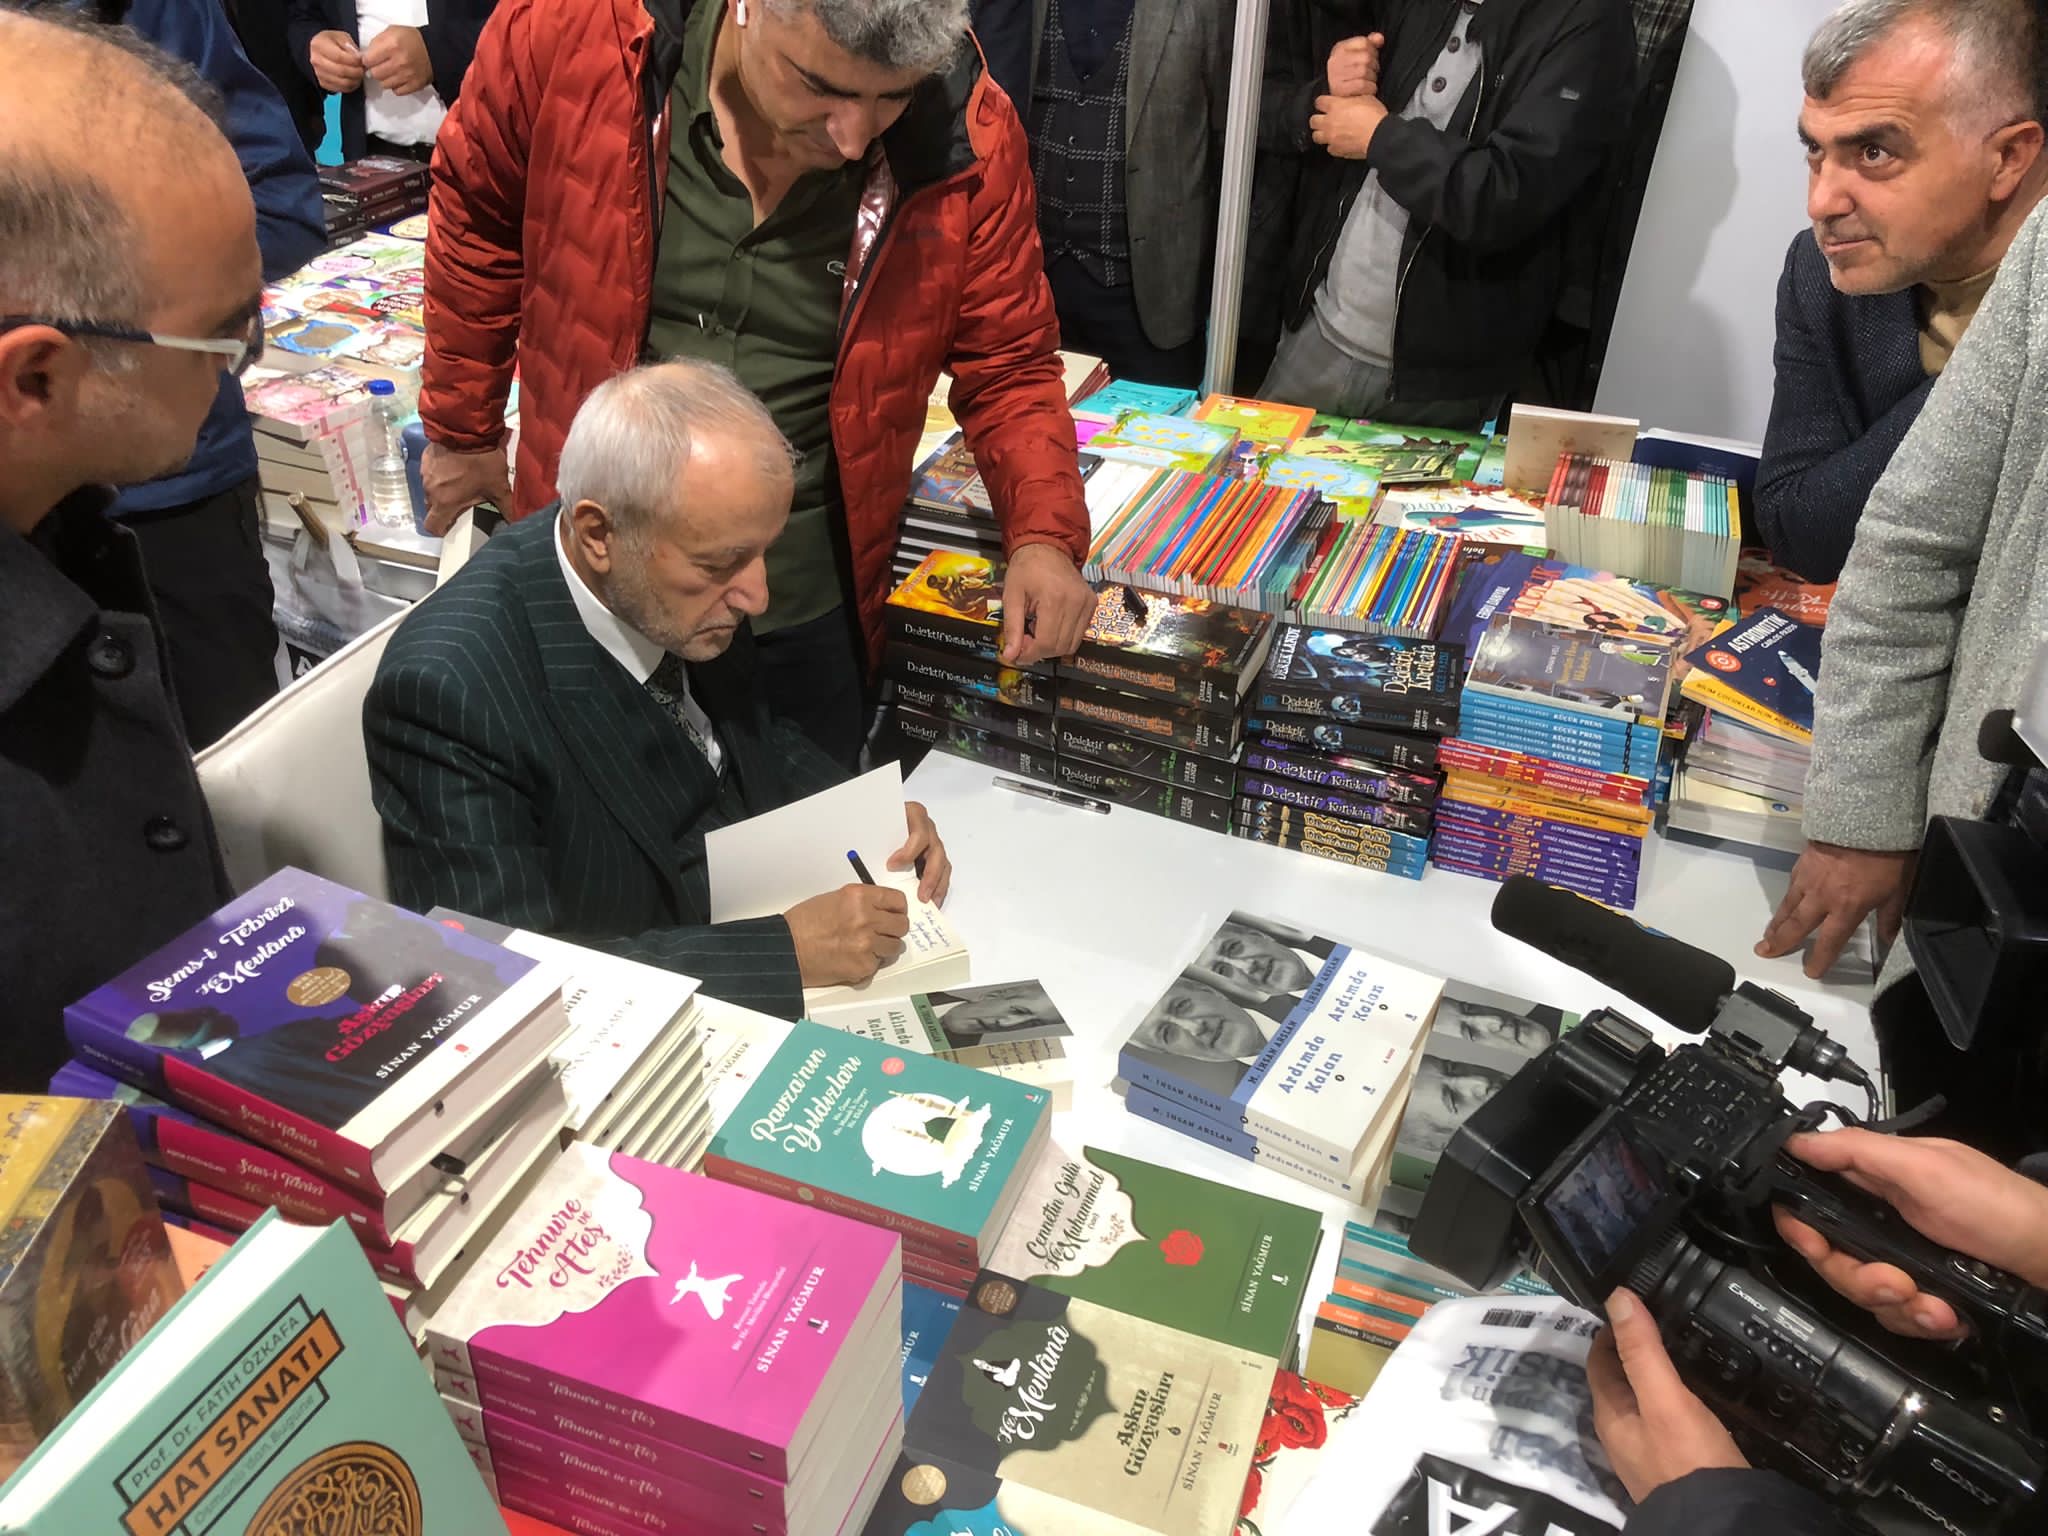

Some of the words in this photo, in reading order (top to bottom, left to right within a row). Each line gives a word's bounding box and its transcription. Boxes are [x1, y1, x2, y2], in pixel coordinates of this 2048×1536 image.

[1383, 646, 1417, 695] Dedektif
[1265, 719, 1305, 737] Dedektif
[1281, 694, 1323, 711] Dedektif
[1063, 731, 1104, 751] Dedektif
[1061, 766, 1102, 785] Dedektif
[1262, 783, 1325, 809] Dedektif
[1327, 800, 1372, 821] Kurukafa
[1264, 757, 1327, 784] Dedektif
[1332, 773, 1376, 795] Kurukafa
[1327, 968, 1368, 1024] Ardımda
[1351, 983, 1386, 1024] Kalan
[376, 1040, 422, 1080] SİNAN
[420, 993, 483, 1042] YAĞMUR
[1255, 1046, 1279, 1076] İHSAN
[1272, 1018, 1298, 1050] ARSLAN
[1278, 1033, 1327, 1095] Ardımda
[1304, 1051, 1344, 1095] Kalan
[1186, 1091, 1223, 1114] ARSLAN
[968, 1160, 991, 1193] SİNAN
[987, 1117, 1015, 1162] YAĞMUR
[1195, 1122, 1234, 1145] ARSLAN
[496, 1197, 583, 1290] Tennure
[577, 1209, 594, 1227] ve
[548, 1223, 613, 1289] Ateş
[1240, 1276, 1259, 1314] SİNAN
[1252, 1232, 1274, 1278] YAĞMUR
[756, 1326, 790, 1374] SİNAN
[783, 1265, 825, 1324] YAĞMUR
[130, 1447, 168, 1490] Prof.
[171, 1421, 198, 1450] Dr.
[197, 1375, 243, 1423] FATİH
[240, 1314, 302, 1377] ÖZKAFA
[1118, 1387, 1152, 1448] Aşkın
[1123, 1370, 1176, 1477] Gözyaşları
[144, 1449, 215, 1530] HAT
[213, 1335, 326, 1458] SANATI
[1182, 1450, 1204, 1492] SİNAN
[1197, 1391, 1223, 1446] YAĞMUR
